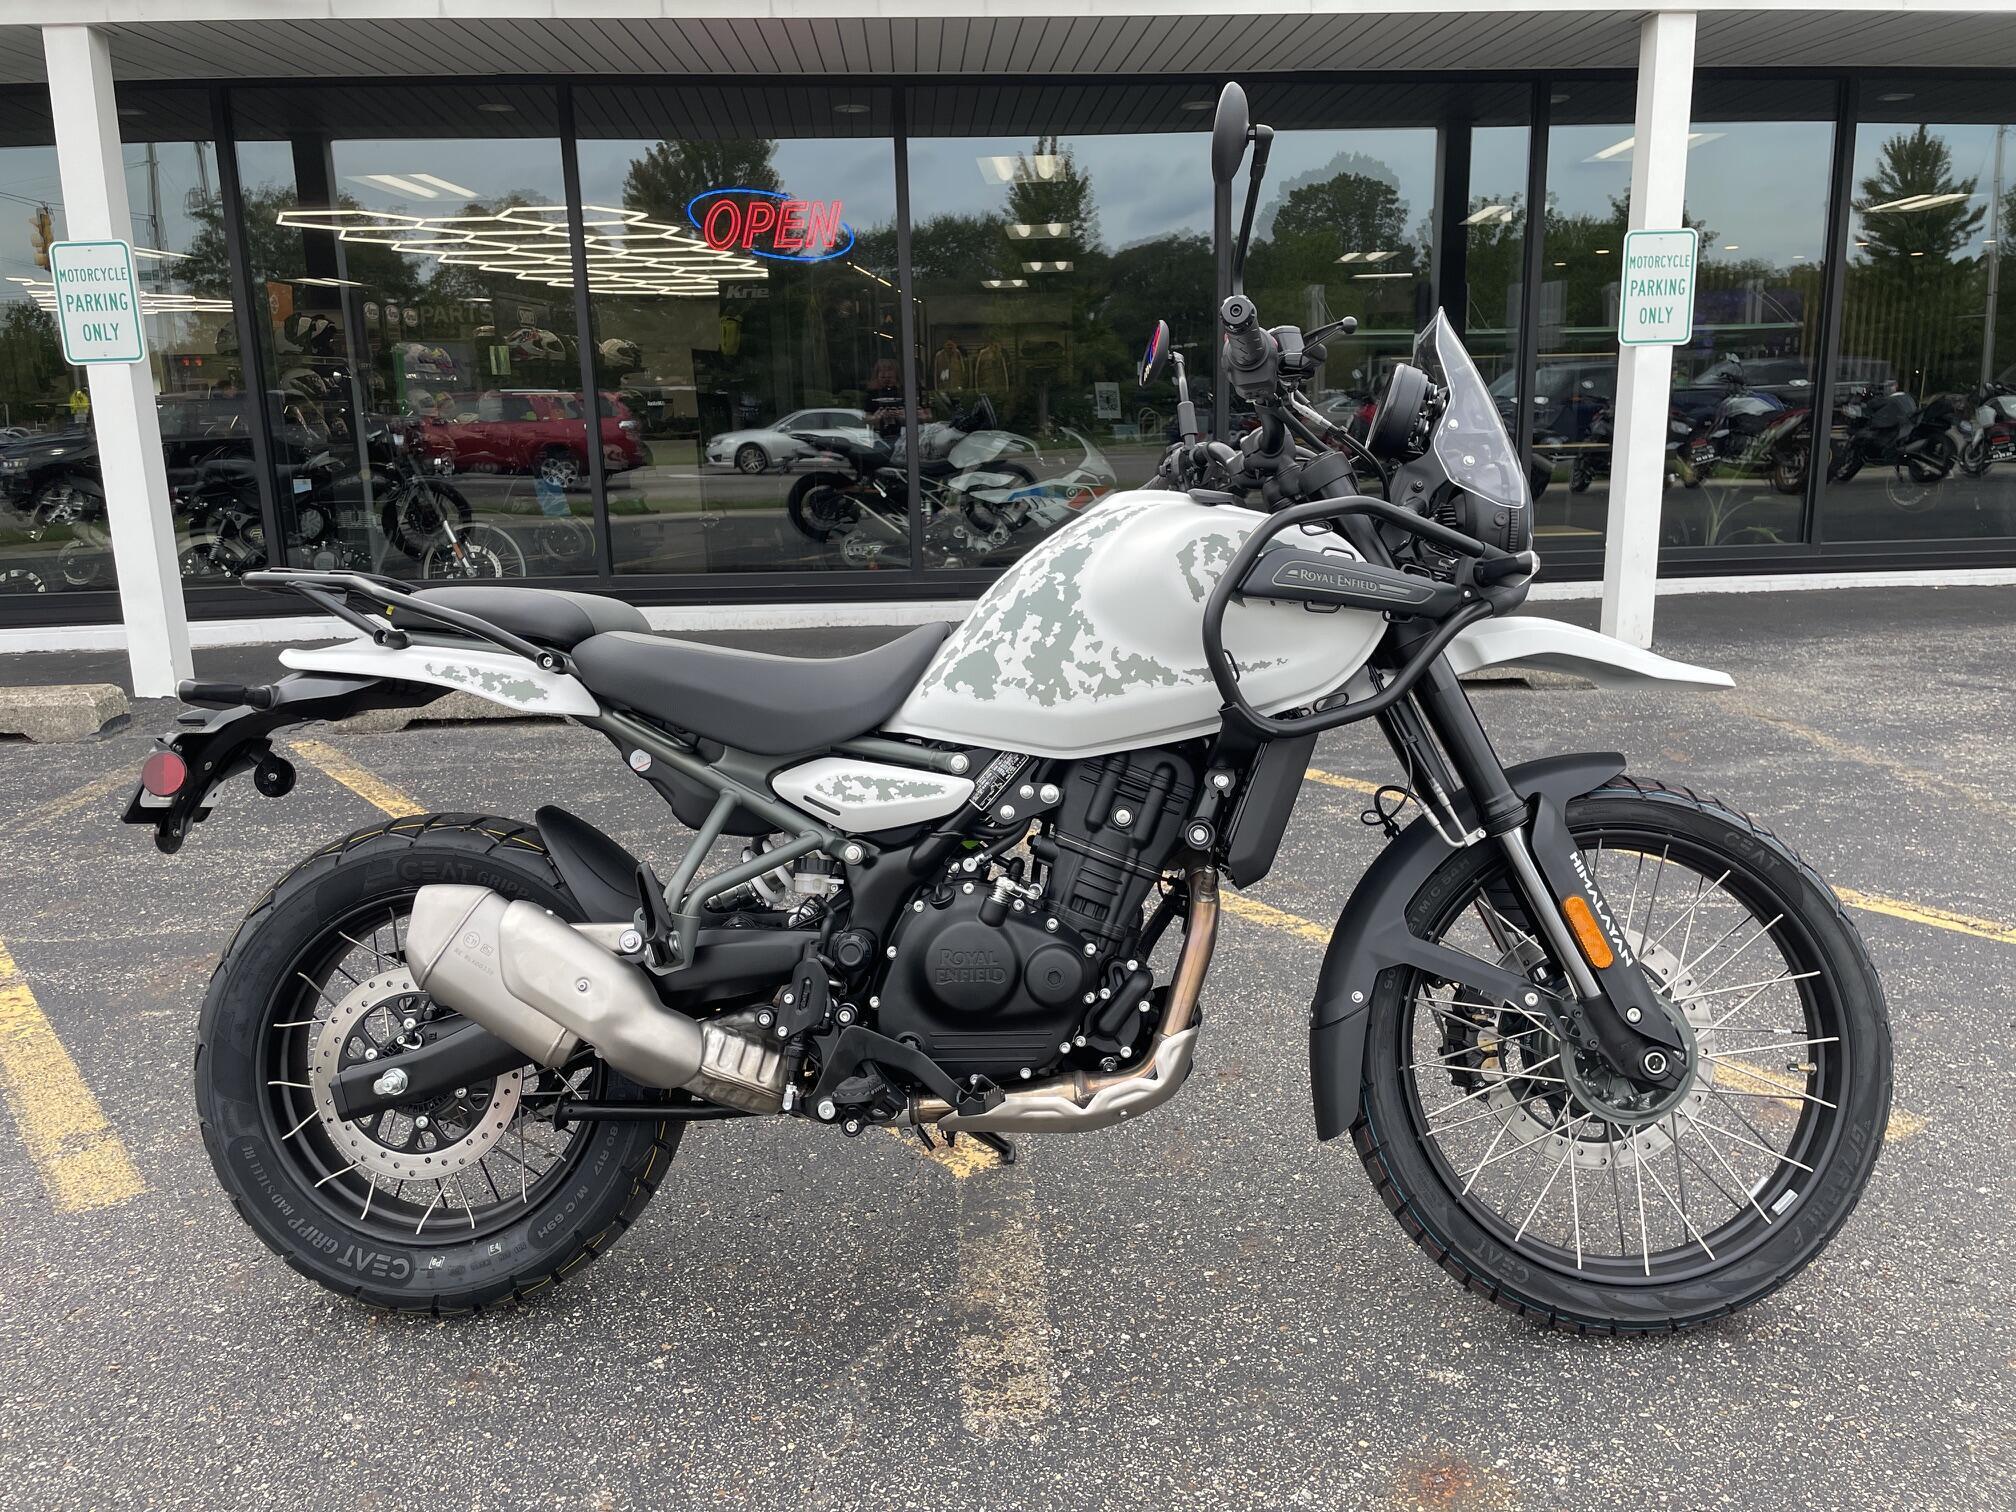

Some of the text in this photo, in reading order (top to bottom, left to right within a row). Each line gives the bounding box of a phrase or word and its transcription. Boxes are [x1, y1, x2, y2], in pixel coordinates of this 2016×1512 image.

[704, 199, 843, 251] OPEN
[1629, 255, 1691, 269] MOTORCYCLE
[59, 267, 128, 283] MOTORCYCLE
[1630, 278, 1686, 296] PARKING
[66, 293, 129, 312] PARKING
[420, 304, 494, 324] PARTS
[1639, 307, 1674, 325] ONLY
[83, 323, 119, 342] ONLY
[1301, 569, 1377, 592] ROYAL ENFIELD
[401, 860, 473, 883] CEAT
[1569, 851, 1634, 968] HIMALAYAN
[939, 948, 1000, 968] ROYAL
[935, 967, 1007, 986] ENFIELD
[247, 1158, 277, 1195] STEEL
[271, 1193, 296, 1217] RAD
[287, 1217, 339, 1254] GRIPP
[336, 1244, 411, 1280] CEAT
